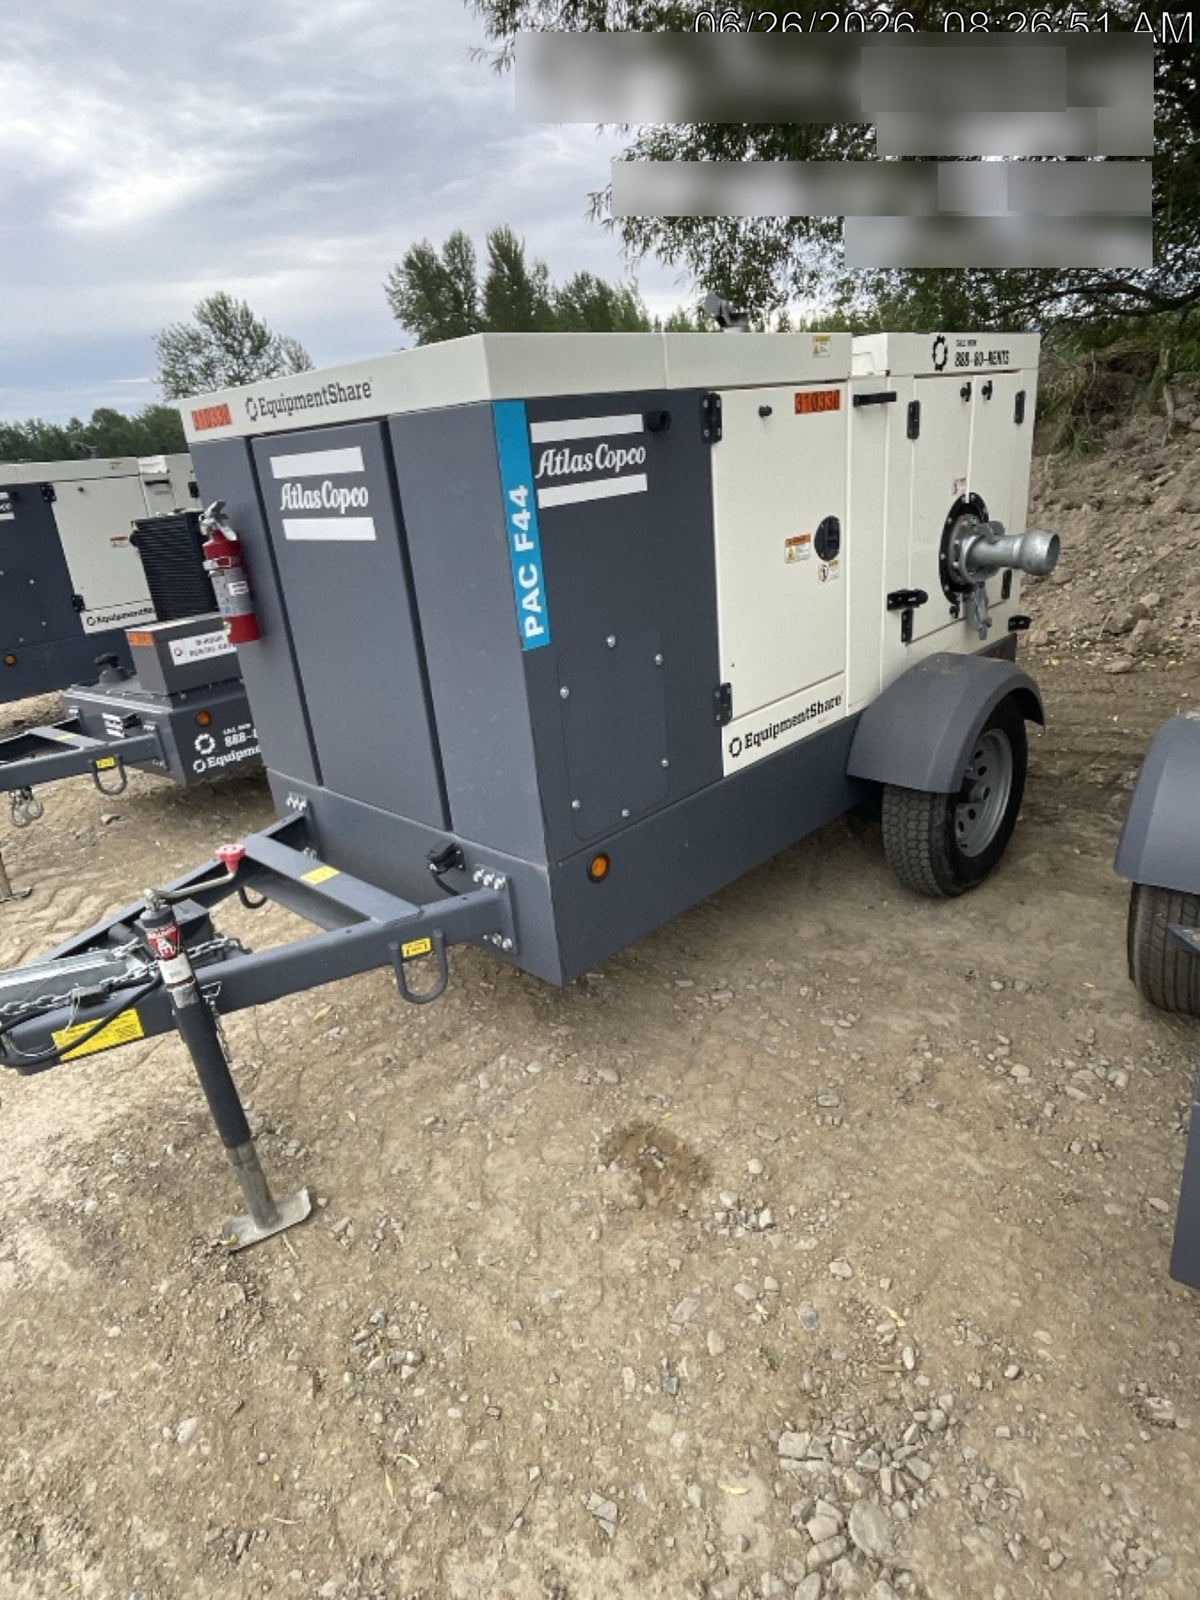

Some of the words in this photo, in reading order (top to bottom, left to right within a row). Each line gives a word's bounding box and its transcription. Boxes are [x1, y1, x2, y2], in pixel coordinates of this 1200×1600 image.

[260, 381, 372, 418] EquipmentShare
[509, 484, 535, 552] F44
[518, 563, 545, 638] PAC
[744, 695, 842, 750] EquipmentShare
